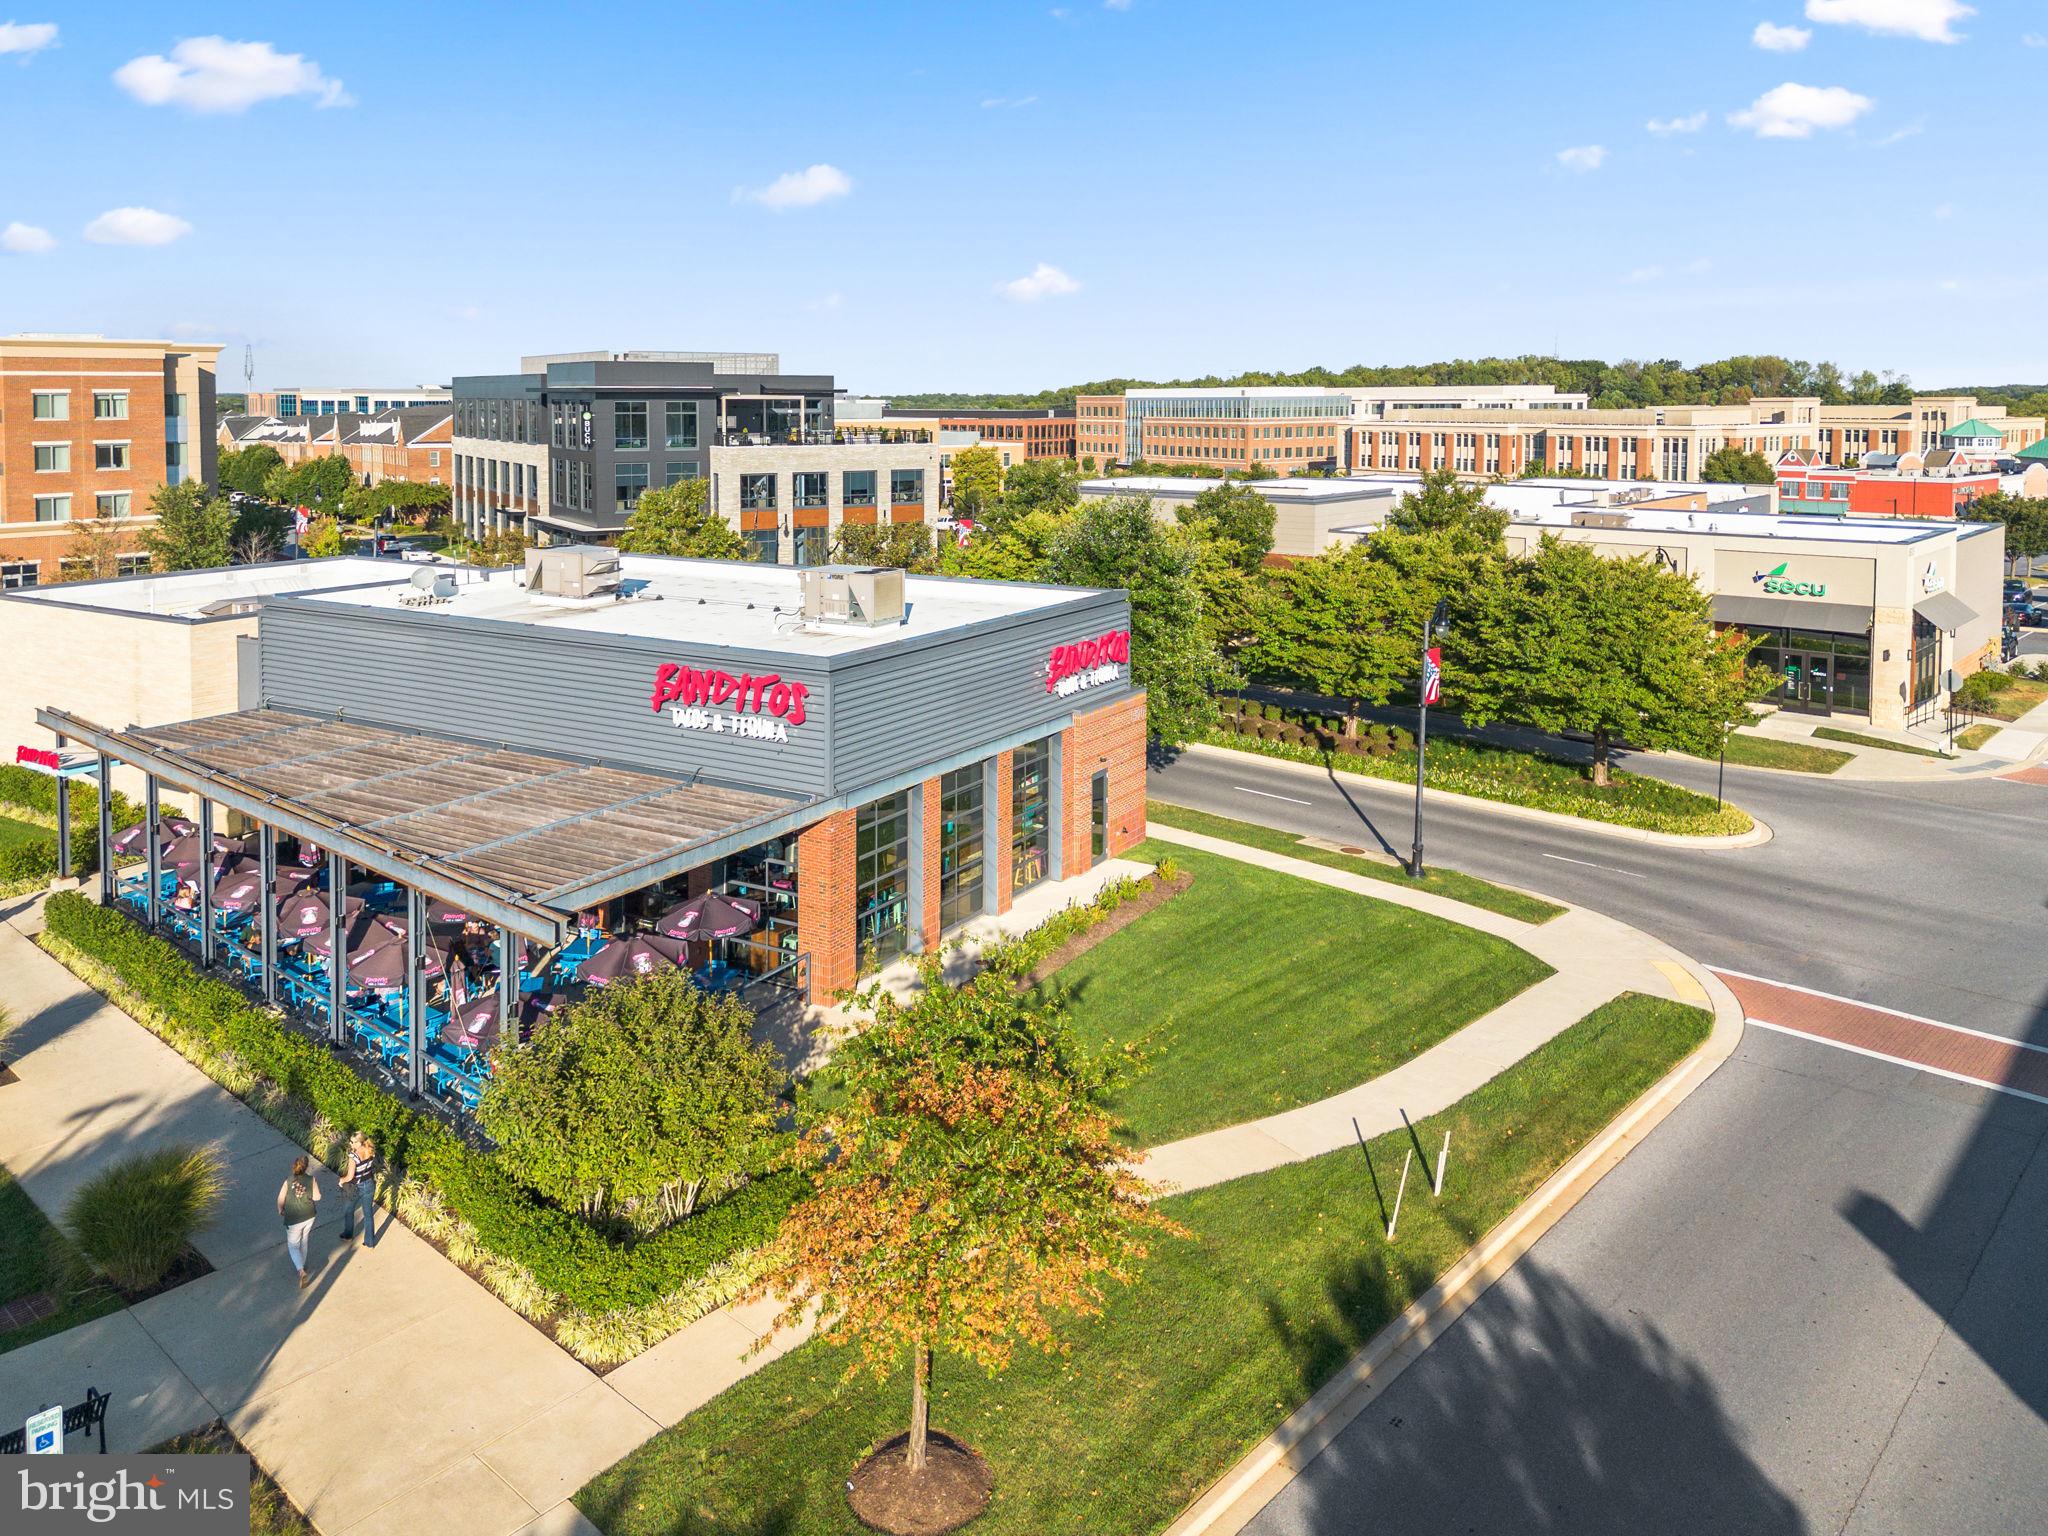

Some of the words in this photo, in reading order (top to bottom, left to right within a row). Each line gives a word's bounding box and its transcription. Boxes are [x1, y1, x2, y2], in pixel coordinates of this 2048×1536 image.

[583, 420, 591, 444] BUCH
[1763, 579, 1827, 597] secu
[1045, 630, 1130, 694] BANDITOS
[650, 663, 809, 726] BANDITOS
[670, 707, 709, 729] TACOS
[712, 714, 725, 732] &
[31, 1420, 58, 1435] PARKING
